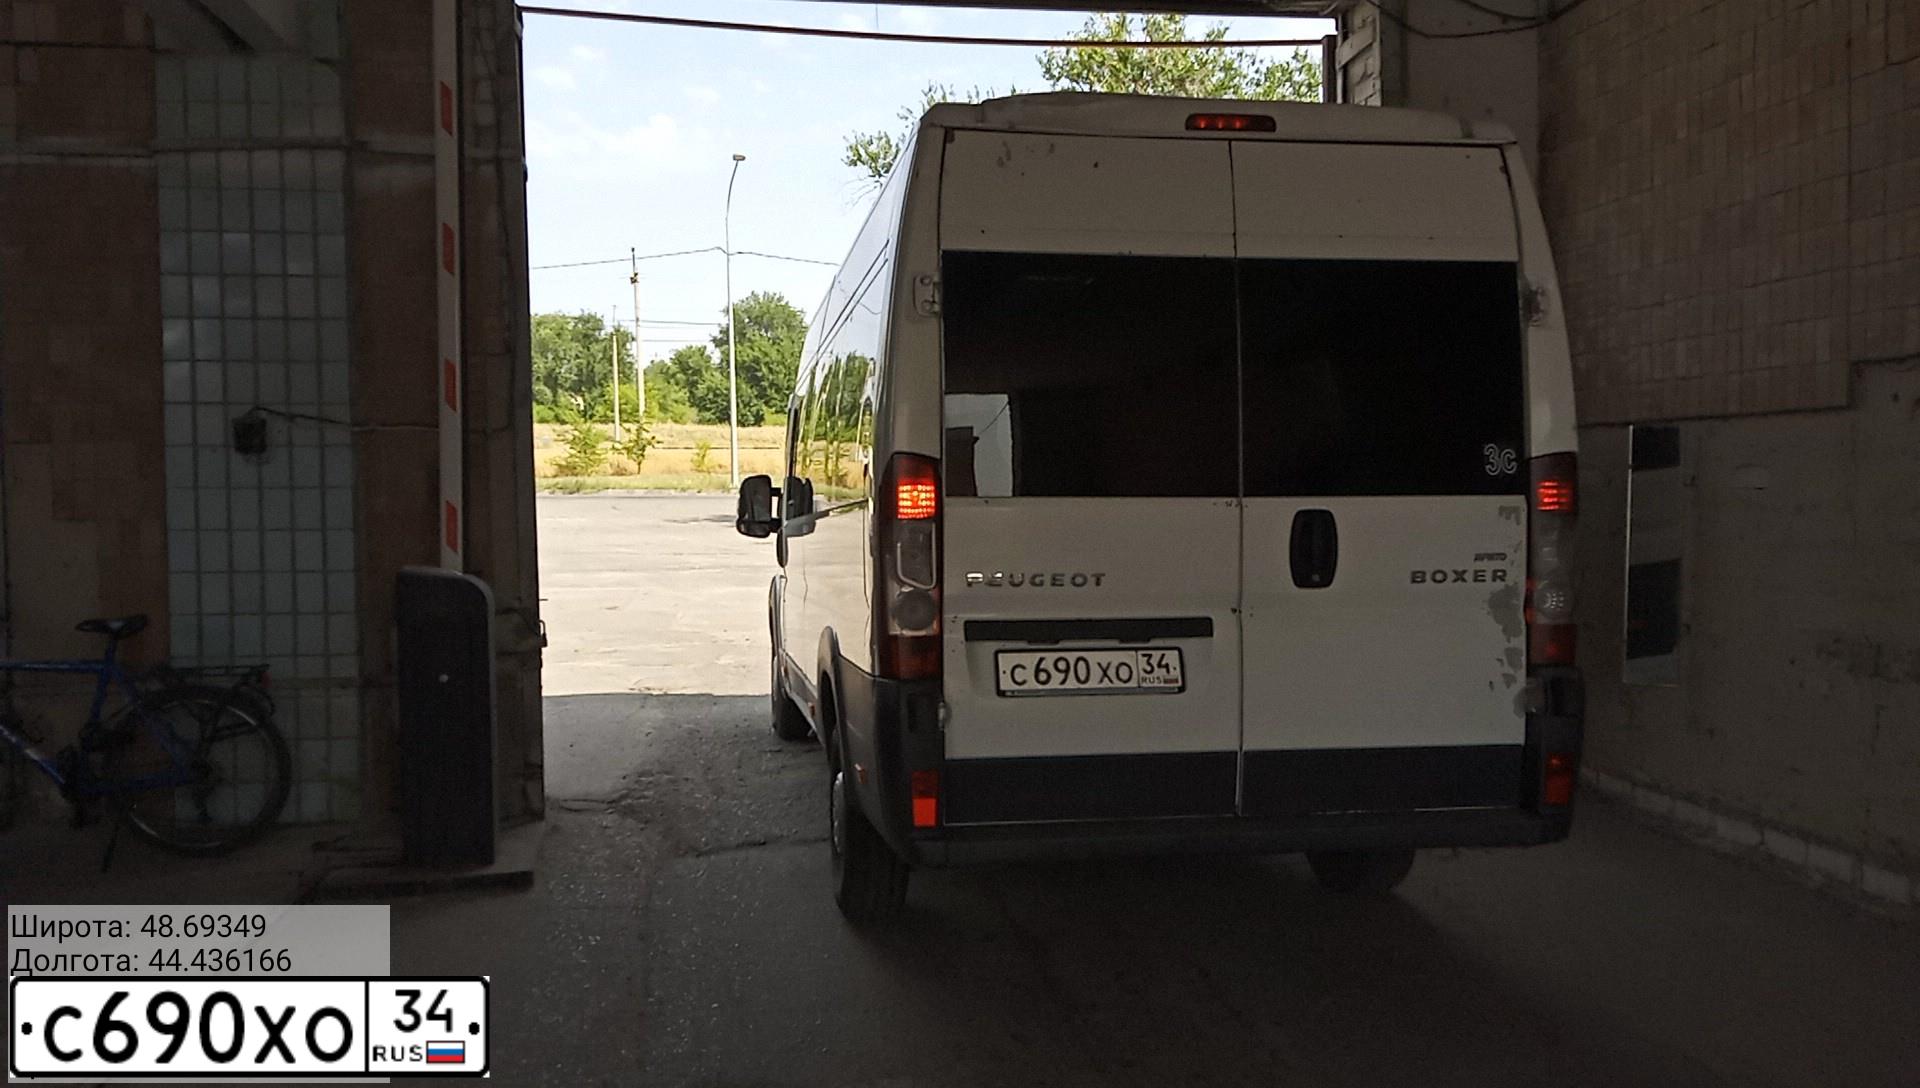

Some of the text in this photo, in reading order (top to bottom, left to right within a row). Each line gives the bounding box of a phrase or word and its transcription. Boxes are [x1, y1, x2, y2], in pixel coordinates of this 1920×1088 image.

[966, 571, 1106, 587] PEUGEOT
[1411, 569, 1506, 584] BOXER
[1141, 653, 1170, 675] 34
[1141, 677, 1162, 685] RUS
